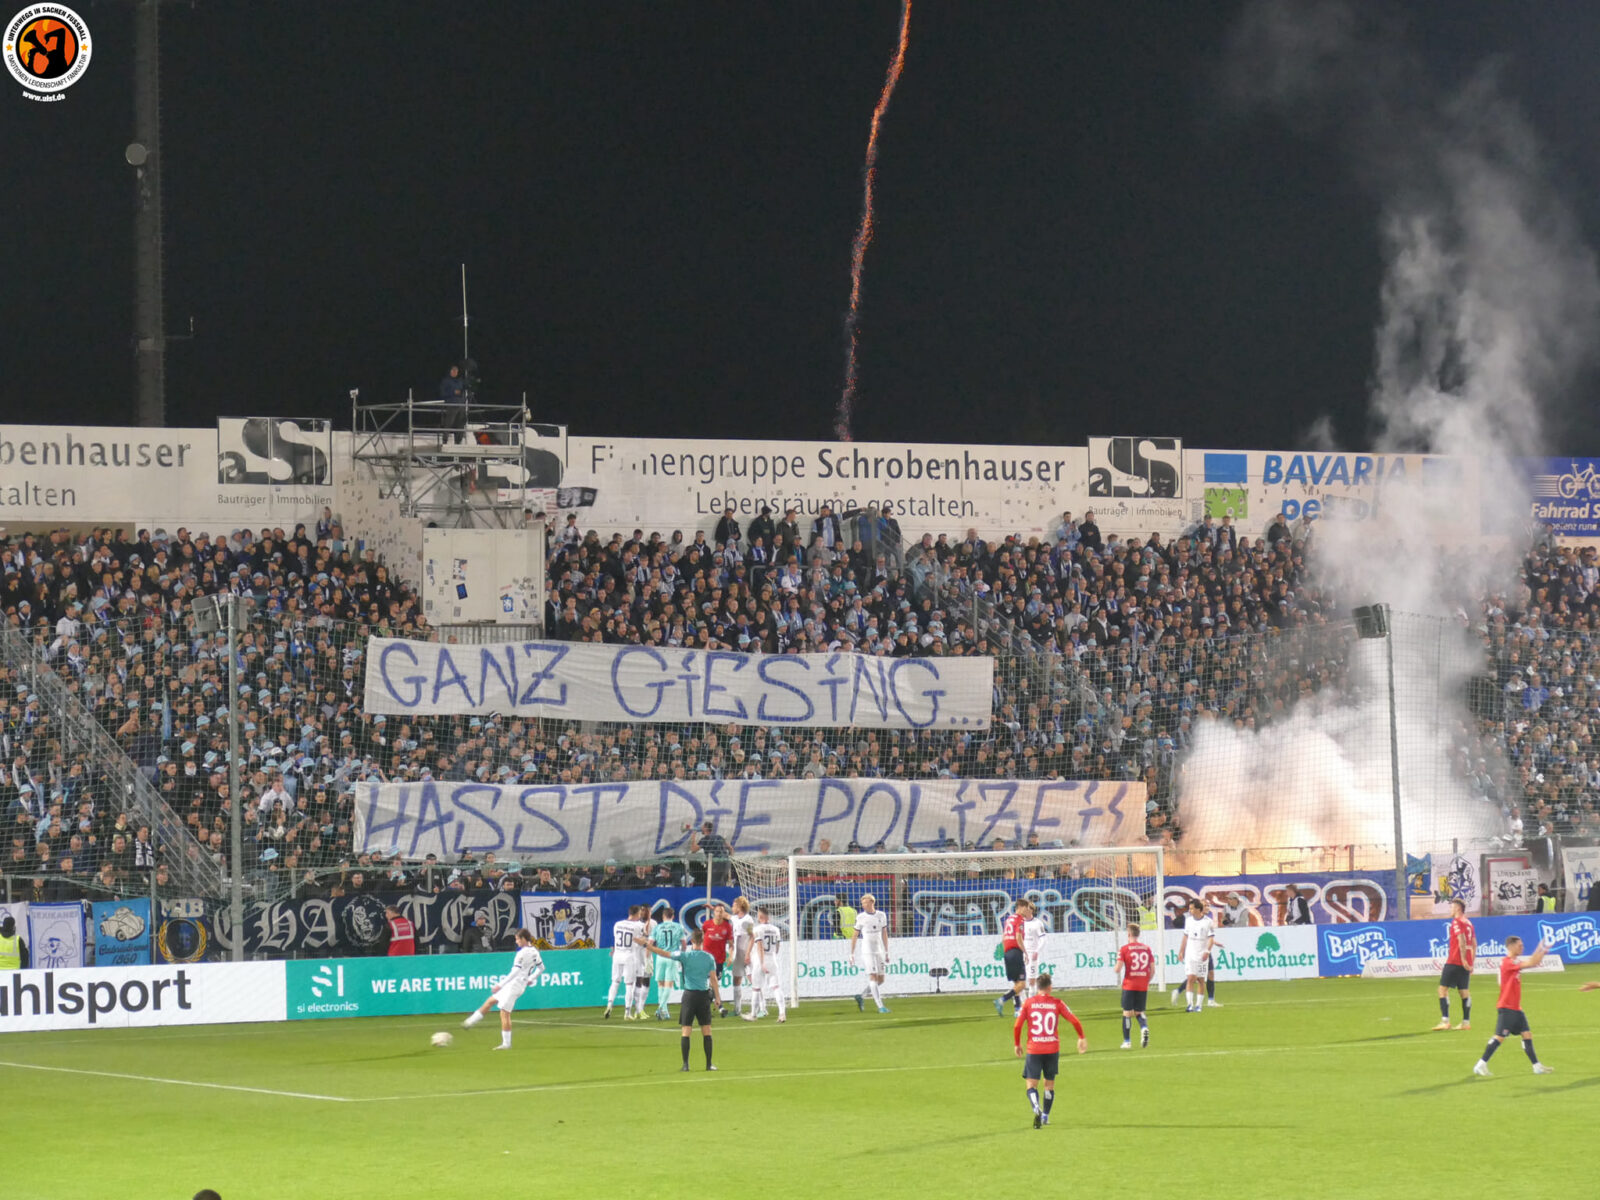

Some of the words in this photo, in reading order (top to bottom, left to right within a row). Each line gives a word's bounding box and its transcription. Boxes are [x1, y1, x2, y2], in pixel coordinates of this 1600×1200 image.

[817, 447, 1066, 483] Schrobenhauser
[1262, 453, 1408, 486] BAVARIA
[277, 494, 332, 505] Immobilien
[696, 490, 859, 516] Lebensräume
[1530, 501, 1591, 519] Fahrrad
[380, 642, 569, 708] GANZ
[364, 782, 630, 857] HASST
[655, 779, 782, 855] DIE
[615, 930, 634, 948] 30
[662, 929, 674, 949] 11
[763, 934, 778, 952] 34
[1075, 952, 1104, 969] Das
[1129, 951, 1149, 971] 39
[1214, 946, 1316, 976] Alpenbauer
[1358, 940, 1395, 966] Park
[371, 979, 397, 994] WE
[399, 977, 433, 993] ARE
[434, 976, 466, 991] THE
[541, 971, 584, 988] PART.
[797, 962, 826, 978] Das
[948, 956, 1057, 985] Alpener
[297, 1003, 306, 1013] si
[307, 1001, 360, 1013] electronics
[1030, 1010, 1057, 1036] 30
